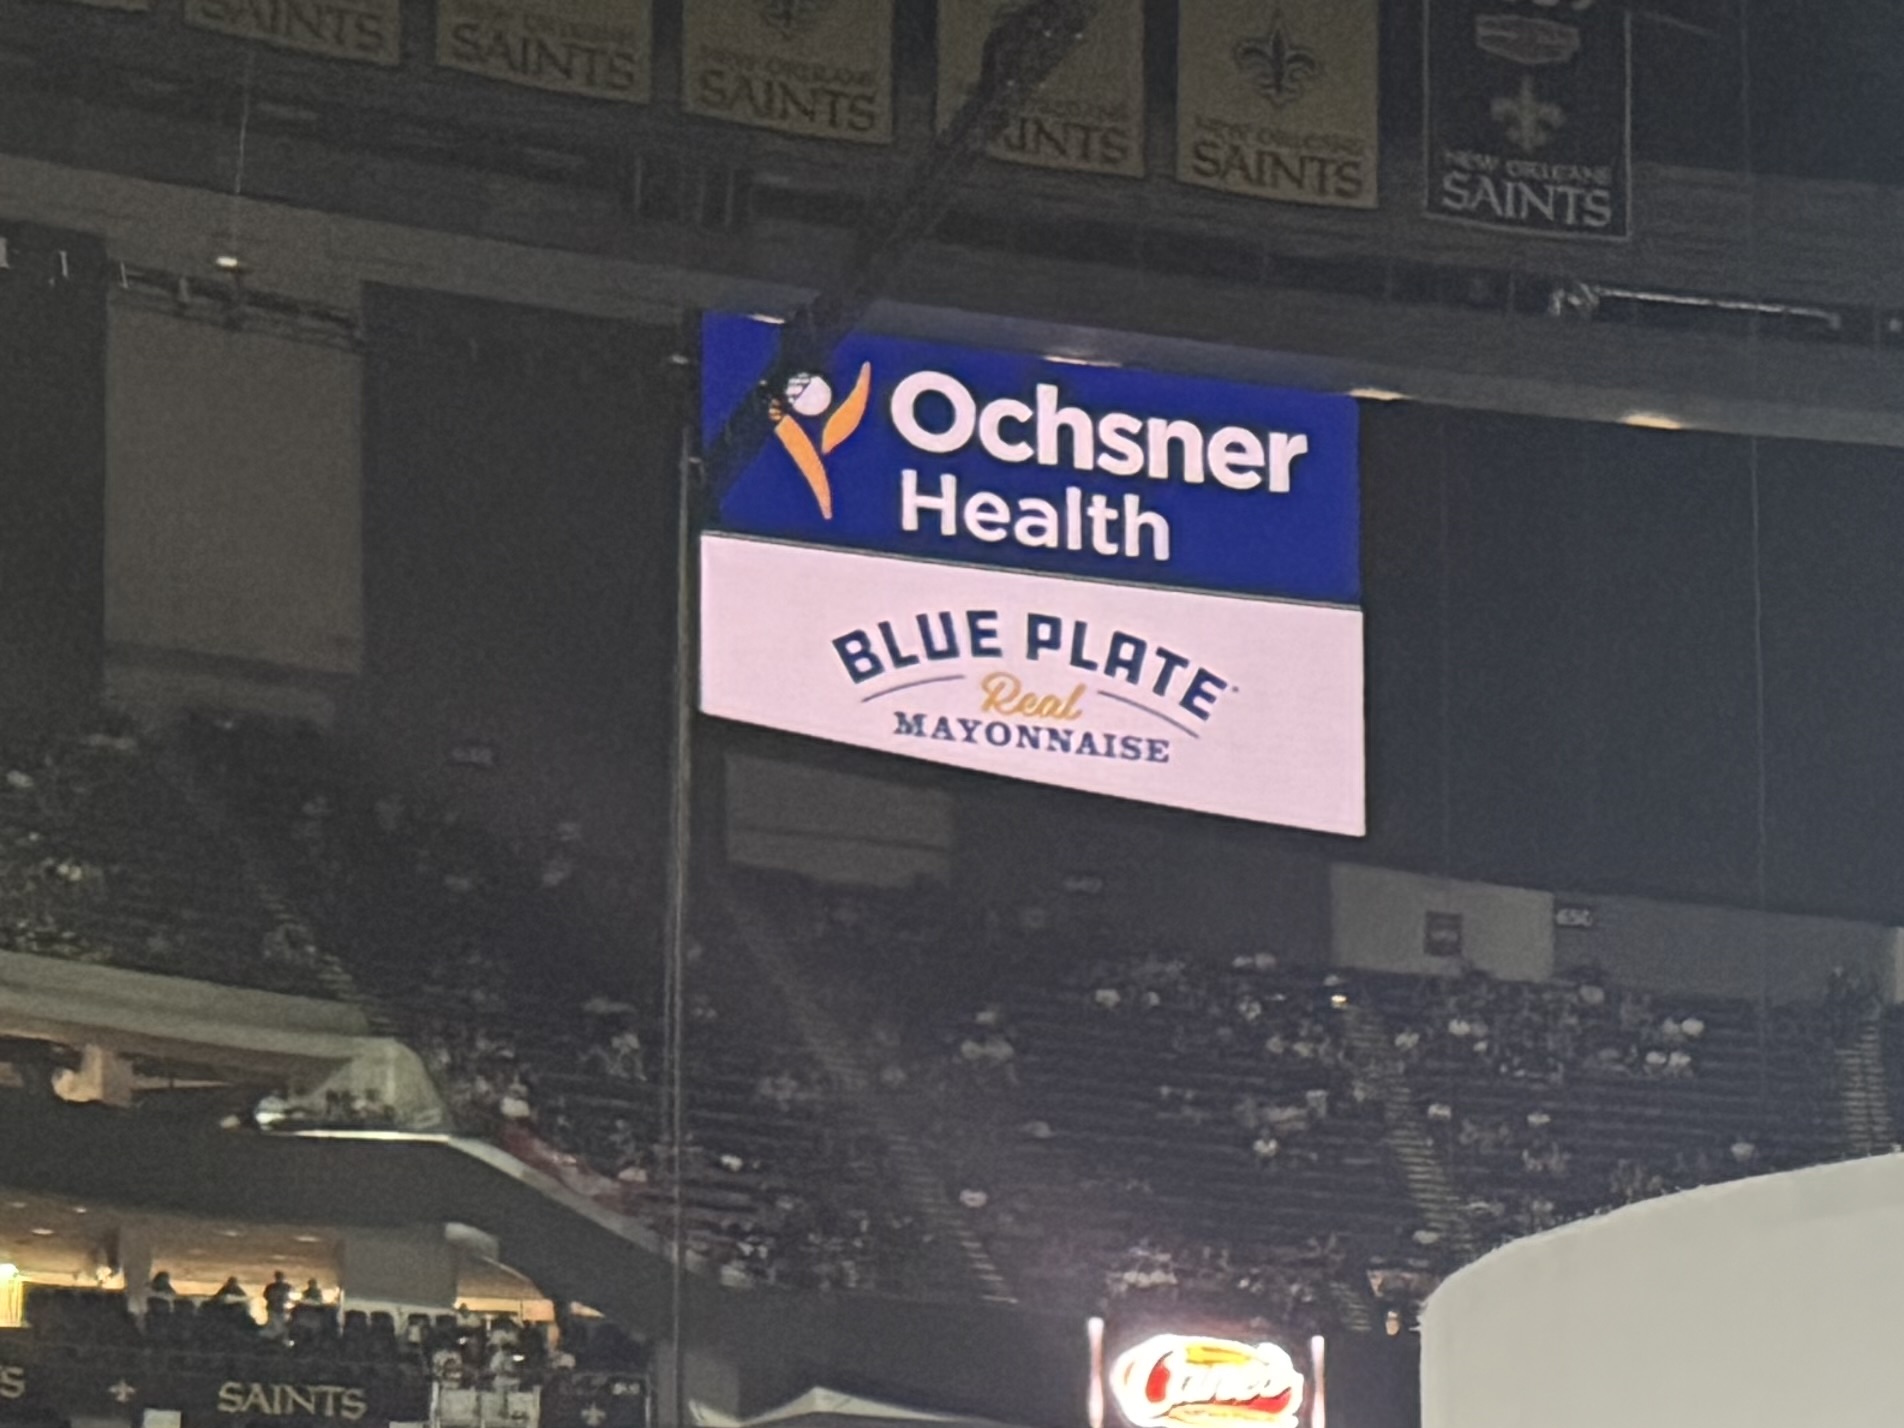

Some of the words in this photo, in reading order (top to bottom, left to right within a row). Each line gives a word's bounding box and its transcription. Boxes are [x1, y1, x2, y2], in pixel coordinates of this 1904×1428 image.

[452, 22, 634, 91] SAINTS
[699, 69, 876, 132] SAINTS
[1003, 116, 1129, 164] INTS
[1193, 139, 1364, 198] SAINTS
[1440, 171, 1613, 228] SAINTS
[890, 370, 1308, 493] Ochsner
[900, 470, 1170, 560] Health
[832, 610, 1004, 686] BLUE
[1025, 613, 1229, 722] PLATE
[980, 671, 1087, 721] Real
[893, 711, 1171, 764] MAYONNAISE
[217, 1381, 367, 1420] SAINTS
